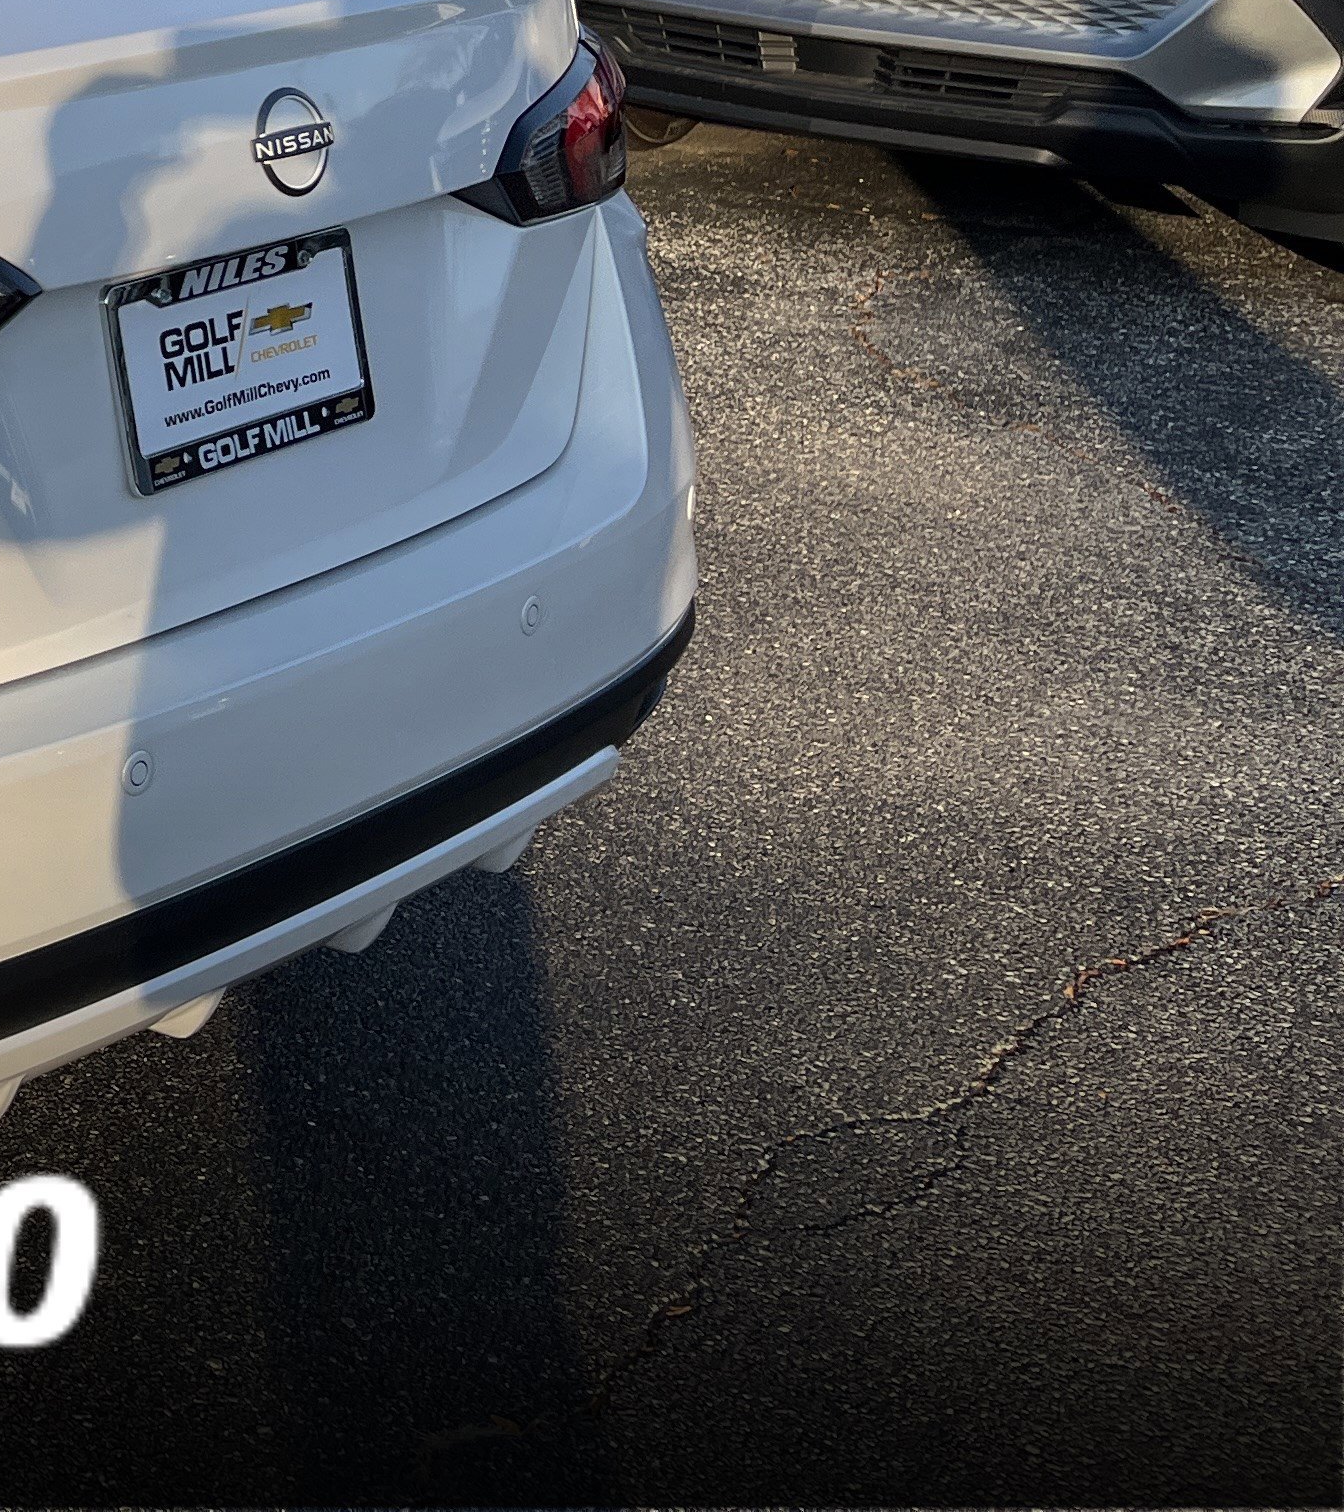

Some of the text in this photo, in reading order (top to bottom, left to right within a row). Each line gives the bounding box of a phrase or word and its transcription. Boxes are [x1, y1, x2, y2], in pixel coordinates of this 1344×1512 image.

[255, 125, 334, 160] NISSAN
[178, 245, 289, 300] NILES
[159, 309, 244, 360] GOLF
[250, 335, 318, 364] CHEVROLET
[163, 346, 236, 392] MILL
[164, 368, 331, 428] www.GolfMillChevy.com
[198, 410, 320, 470] GOLF MILL
